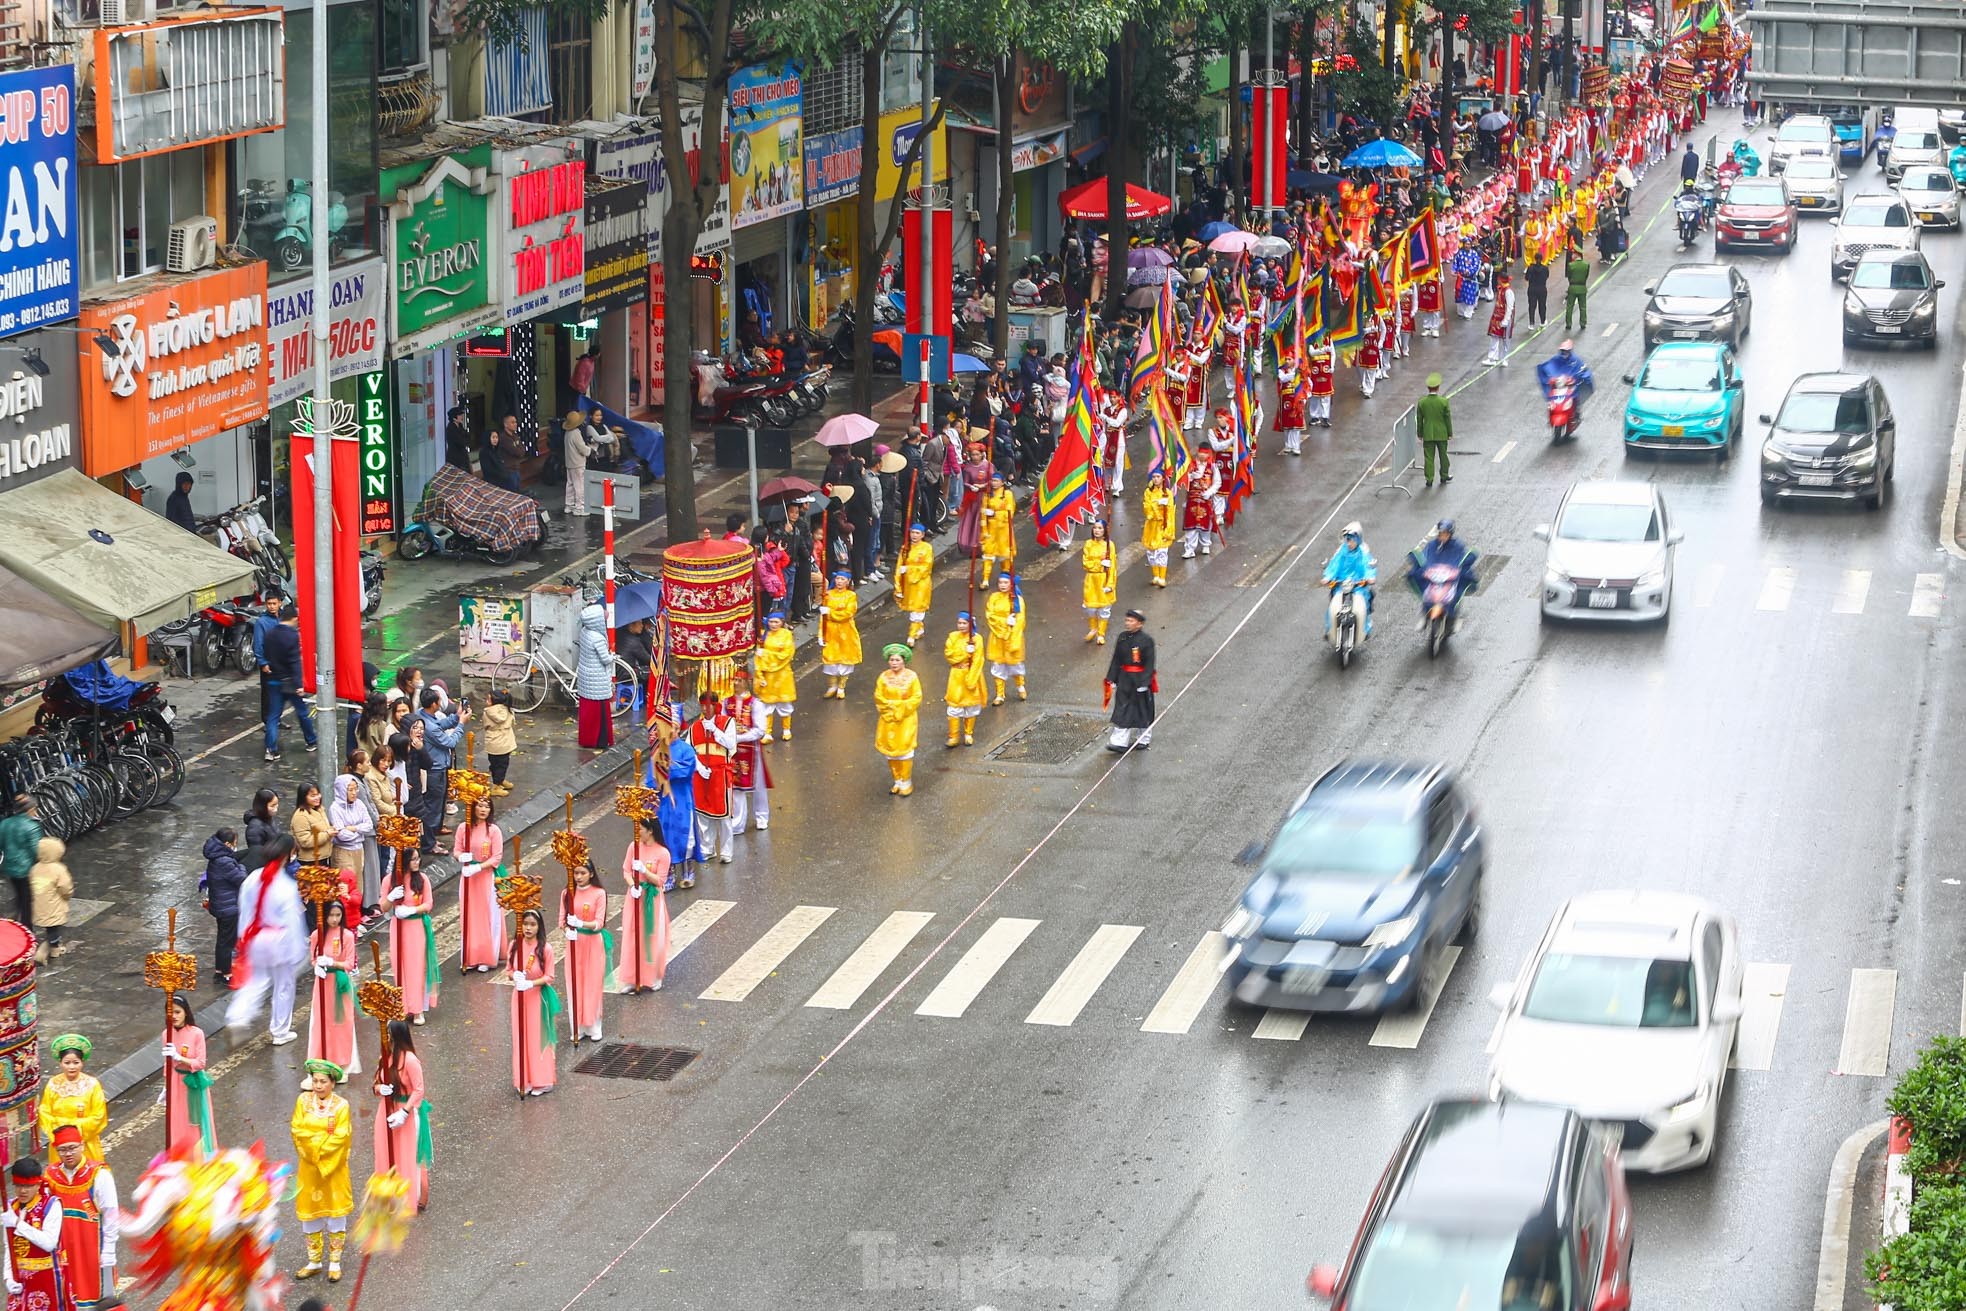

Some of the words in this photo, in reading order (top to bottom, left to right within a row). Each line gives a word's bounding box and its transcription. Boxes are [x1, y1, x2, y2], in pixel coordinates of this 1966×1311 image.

[41, 84, 69, 137] 50
[732, 83, 751, 109] SIÊU
[751, 85, 765, 108] THỊ
[766, 76, 782, 102] CHÓ
[783, 73, 800, 98] MÈO
[511, 159, 549, 229] KÍNH
[552, 142, 586, 216] MÁT
[37, 257, 70, 291] HÃNG
[398, 239, 480, 291] EVERON
[514, 234, 546, 297] TÂN
[550, 215, 583, 284] TIẾN
[21, 298, 69, 325] 0912.145.033
[148, 300, 214, 358] HỒNG
[214, 294, 262, 338] LAM
[148, 369, 178, 399] Tinh
[178, 365, 207, 390] hoa
[207, 351, 234, 384] quà
[235, 342, 262, 374] Việt
[282, 321, 314, 380] MÁ
[148, 411, 160, 425] The
[163, 403, 185, 422] finest
[187, 397, 196, 412] of
[199, 385, 238, 408] Vietnamese
[240, 378, 256, 396] gifts
[149, 440, 158, 452] 151
